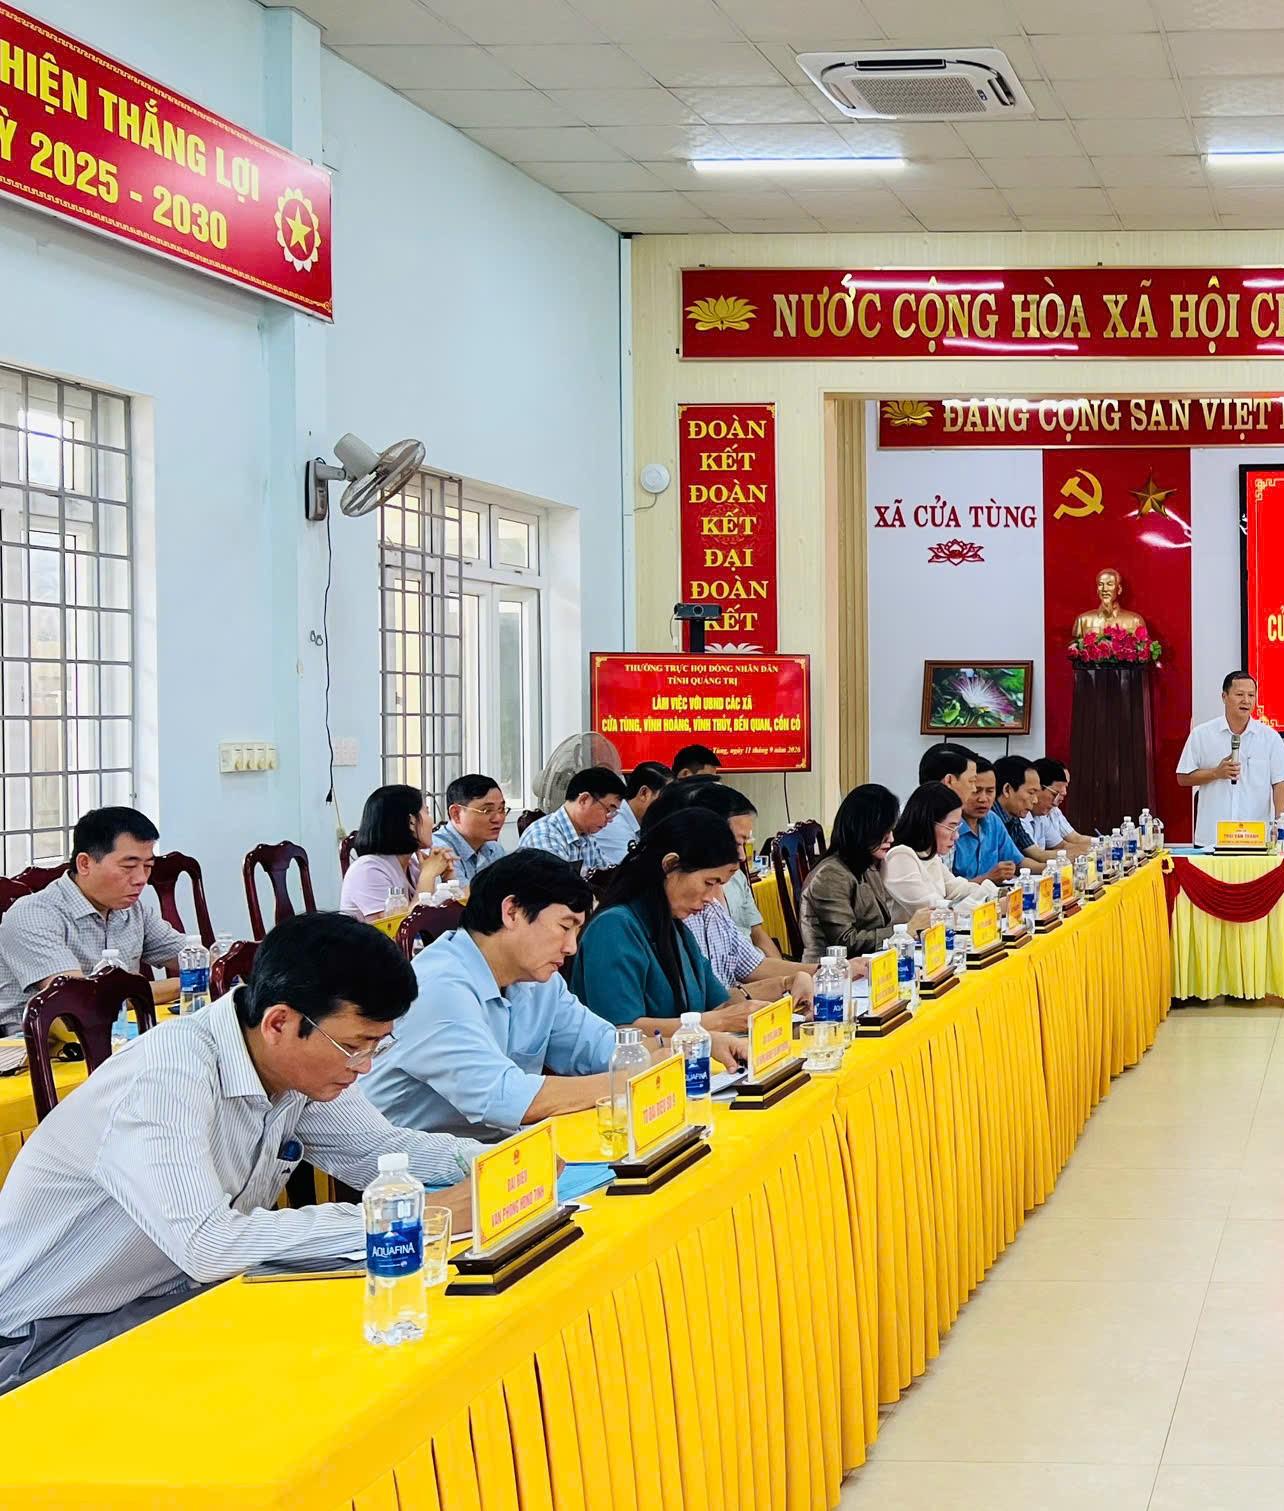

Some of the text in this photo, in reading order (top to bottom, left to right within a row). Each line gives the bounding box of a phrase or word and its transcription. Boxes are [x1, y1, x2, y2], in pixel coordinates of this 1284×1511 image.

[98, 87, 207, 177] THẮNG
[215, 146, 260, 204] LỢI
[30, 131, 119, 204] 2025
[130, 191, 142, 203] -
[152, 185, 228, 250] 2030
[773, 274, 882, 339] NƯỚC
[892, 275, 997, 353] CỘNG
[1012, 276, 1092, 339] HÒA
[1103, 278, 1159, 339] XÃ
[1170, 275, 1240, 353] HỘI
[688, 415, 767, 439] ĐOÀN
[700, 444, 756, 471] KẾT
[689, 479, 767, 503] ĐOÀN
[701, 508, 757, 535] KẾT
[874, 494, 1037, 528] XÃ CỬA TÙNG
[704, 549, 753, 571] ĐẠI
[690, 575, 768, 599] ĐOÀN
[372, 1242, 416, 1258] AQUAFINA
